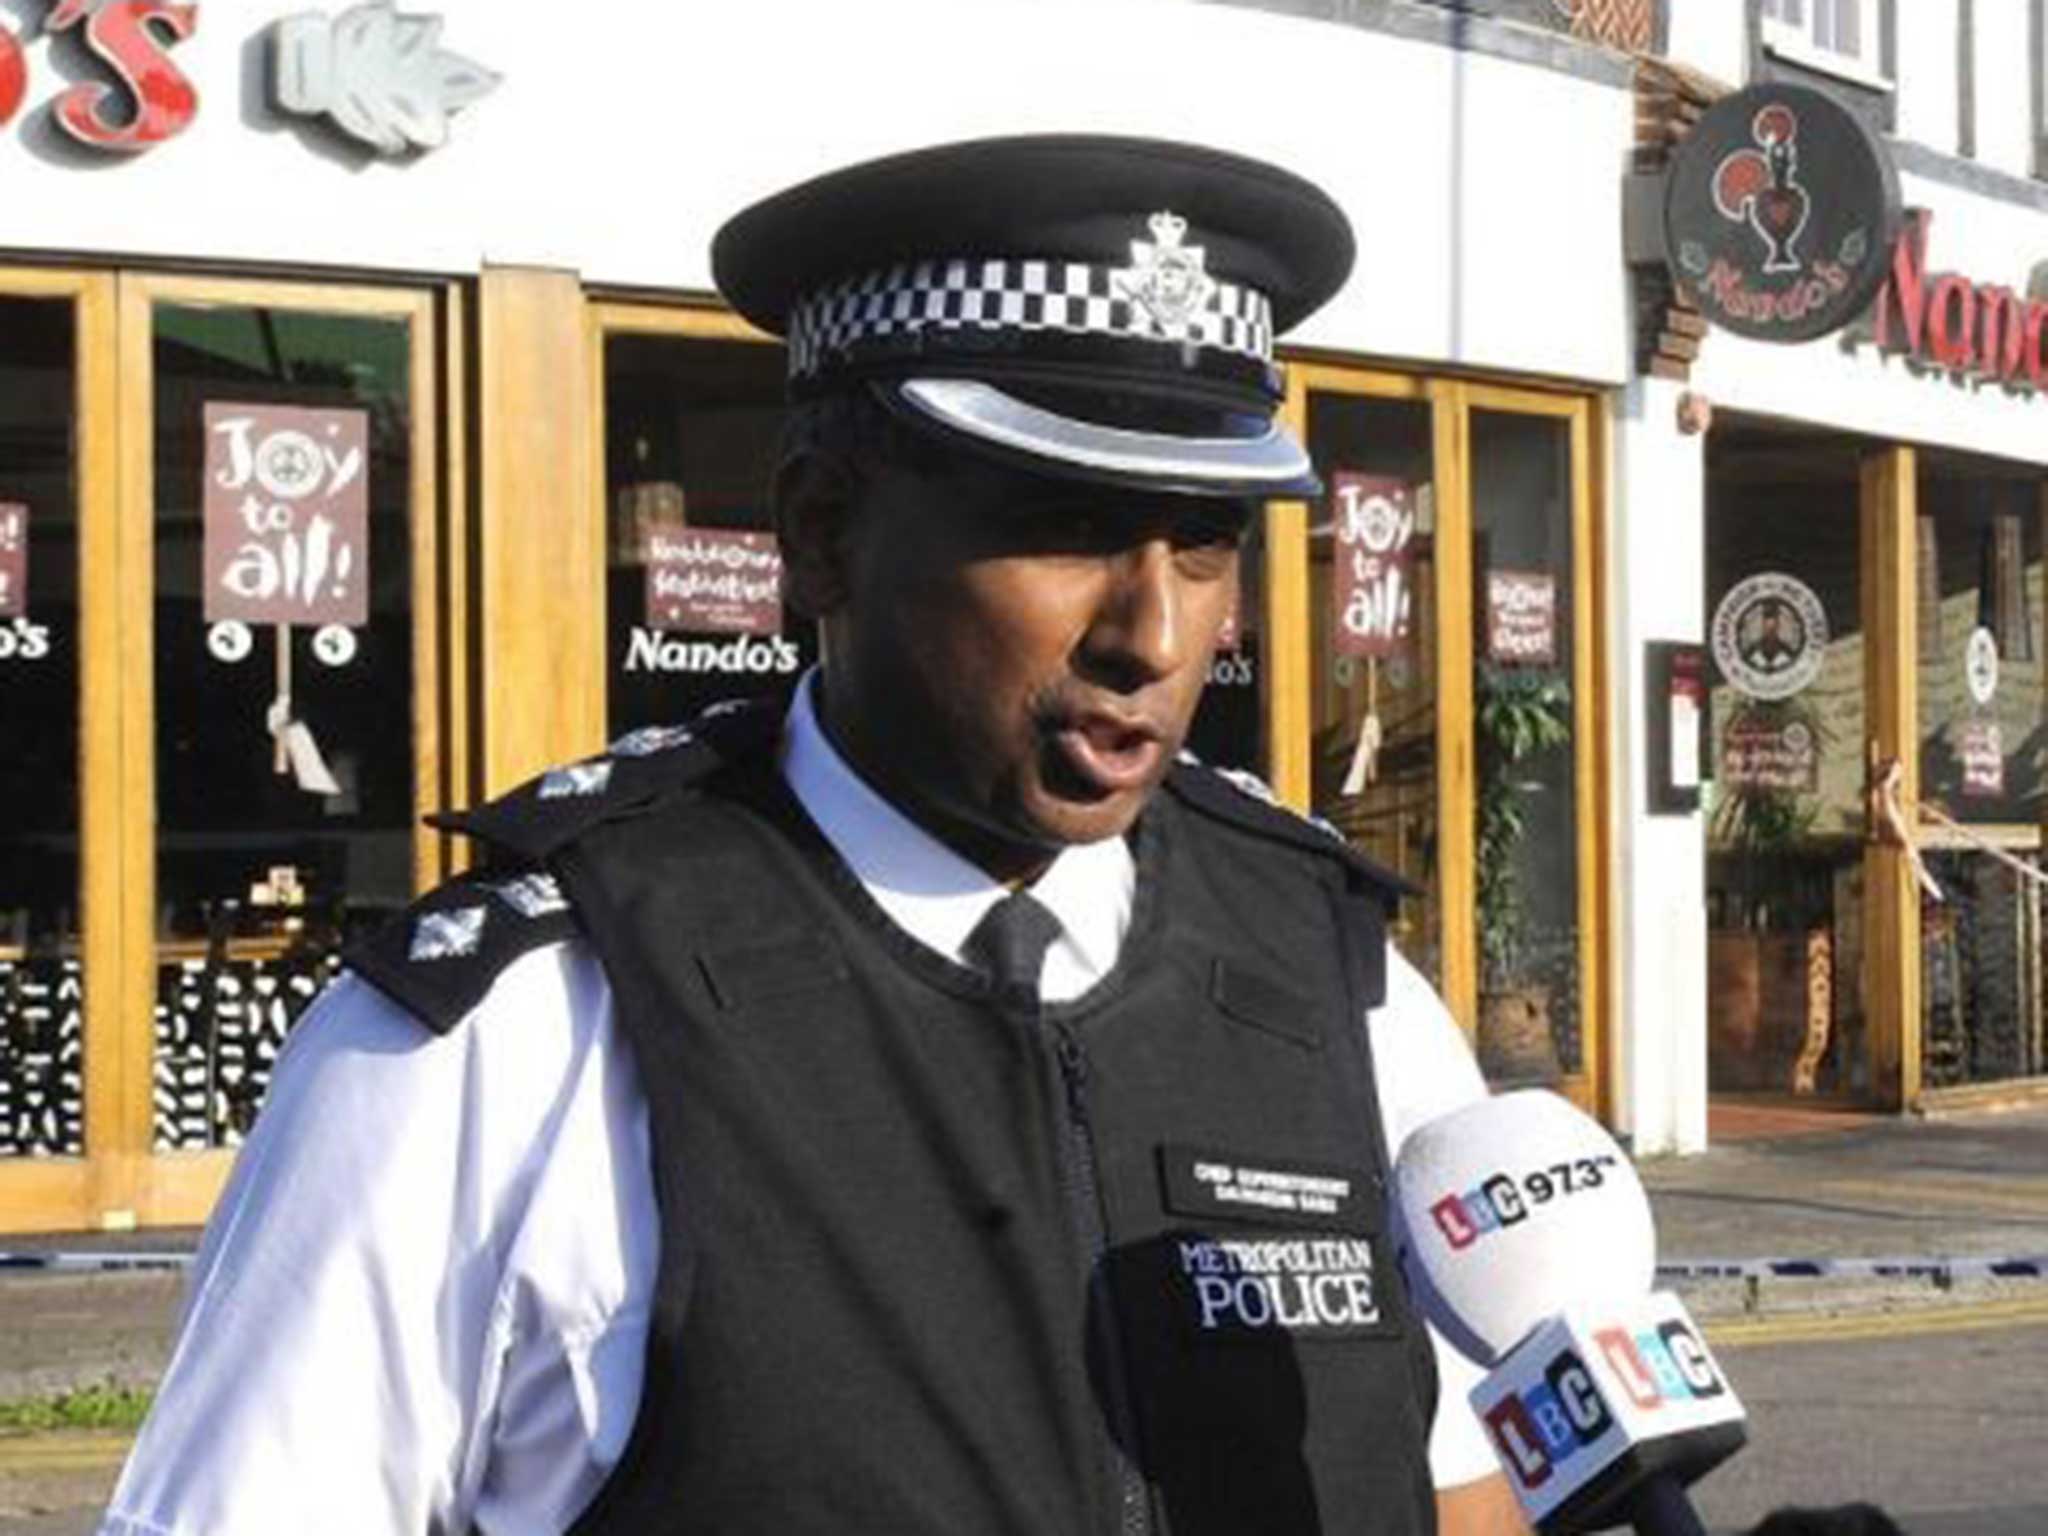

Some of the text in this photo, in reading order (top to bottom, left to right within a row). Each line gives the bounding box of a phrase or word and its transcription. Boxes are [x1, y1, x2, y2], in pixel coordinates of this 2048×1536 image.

[1702, 257, 1848, 324] Nando's
[214, 415, 361, 497] Joy
[239, 495, 294, 536] to
[1339, 485, 1413, 552] Joy
[221, 512, 352, 608] all!
[1353, 549, 1381, 582] to
[1343, 562, 1410, 641] all!
[623, 626, 799, 673] Nando's
[1431, 1172, 1529, 1250] LBC
[1179, 1240, 1373, 1273] METROPOLITAN
[1194, 1271, 1380, 1327] POLICE
[1483, 1348, 1617, 1490] LBC
